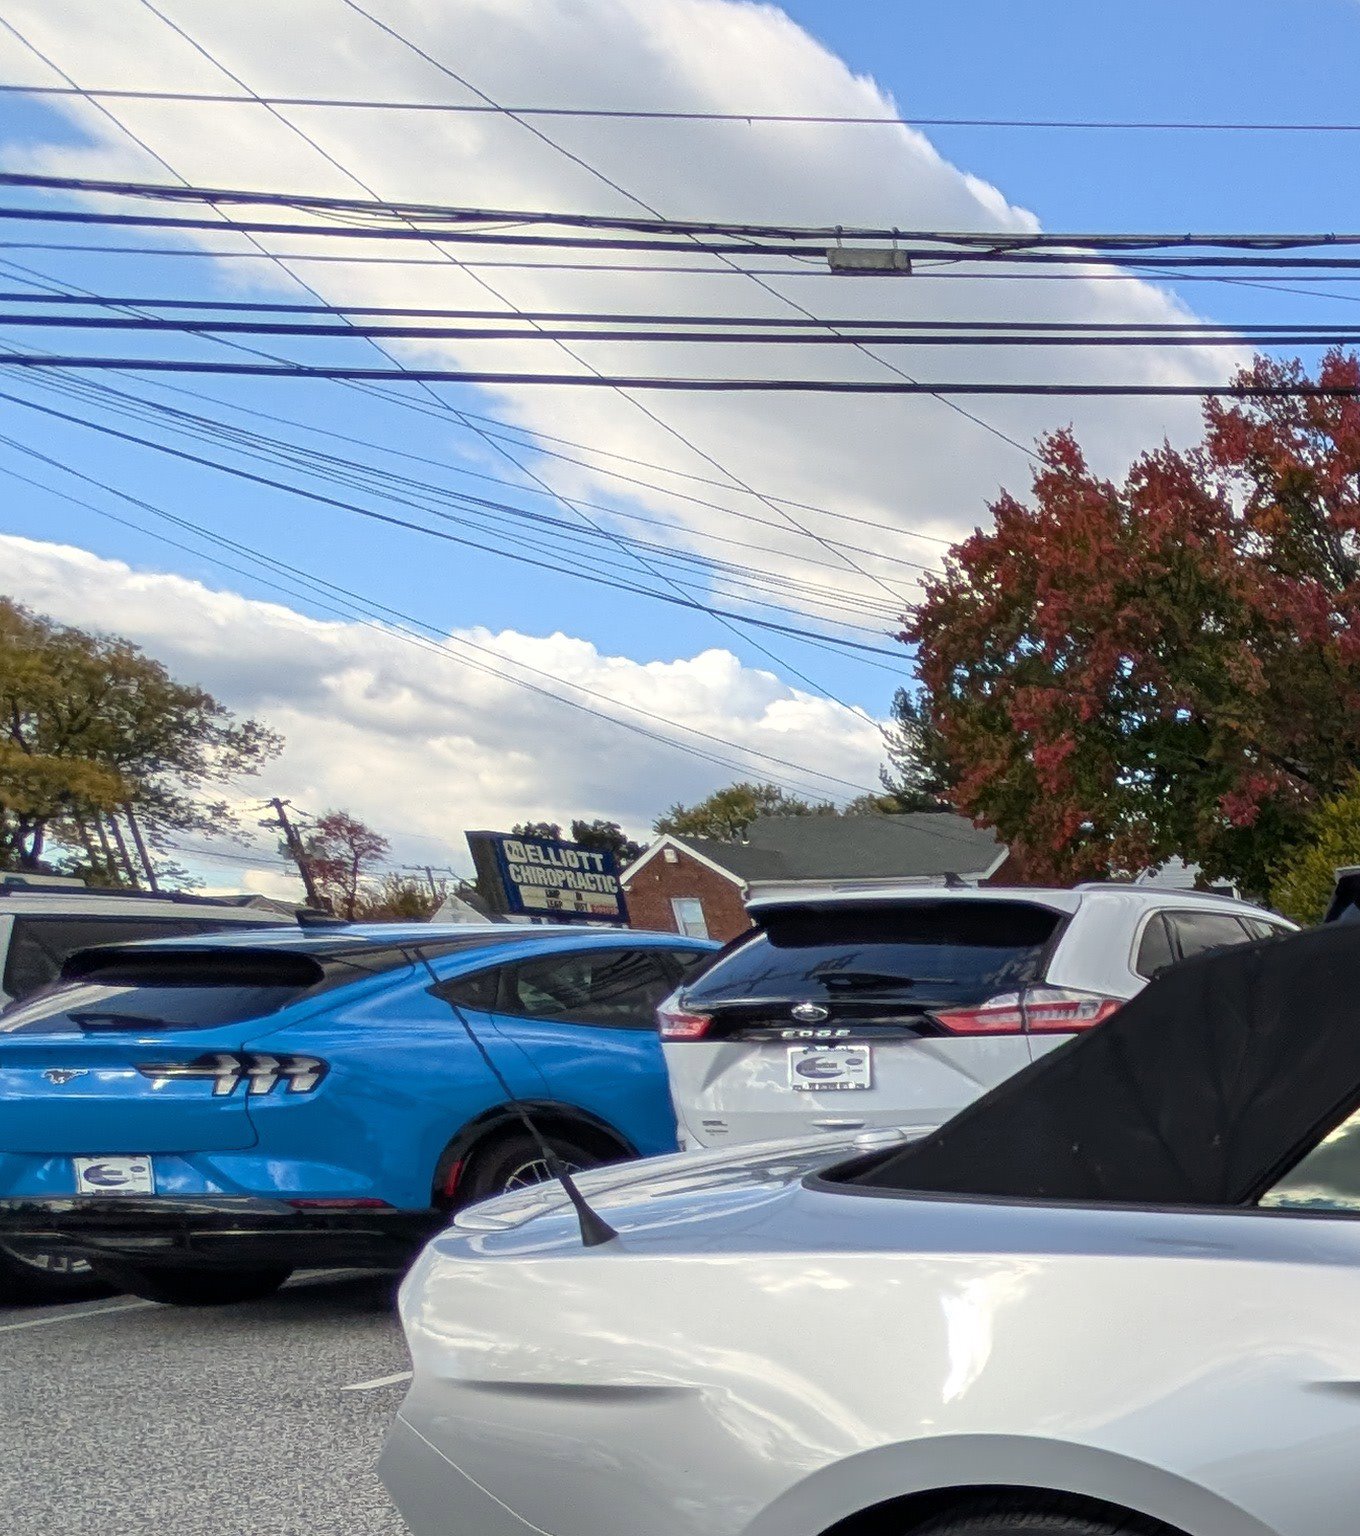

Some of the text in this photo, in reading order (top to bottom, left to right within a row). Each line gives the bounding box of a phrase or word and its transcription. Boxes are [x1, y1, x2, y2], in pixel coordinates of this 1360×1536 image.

[525, 843, 604, 871] ELLIOTT
[508, 863, 618, 894] CHIROPRACTIC
[781, 1029, 851, 1038] EDGE
